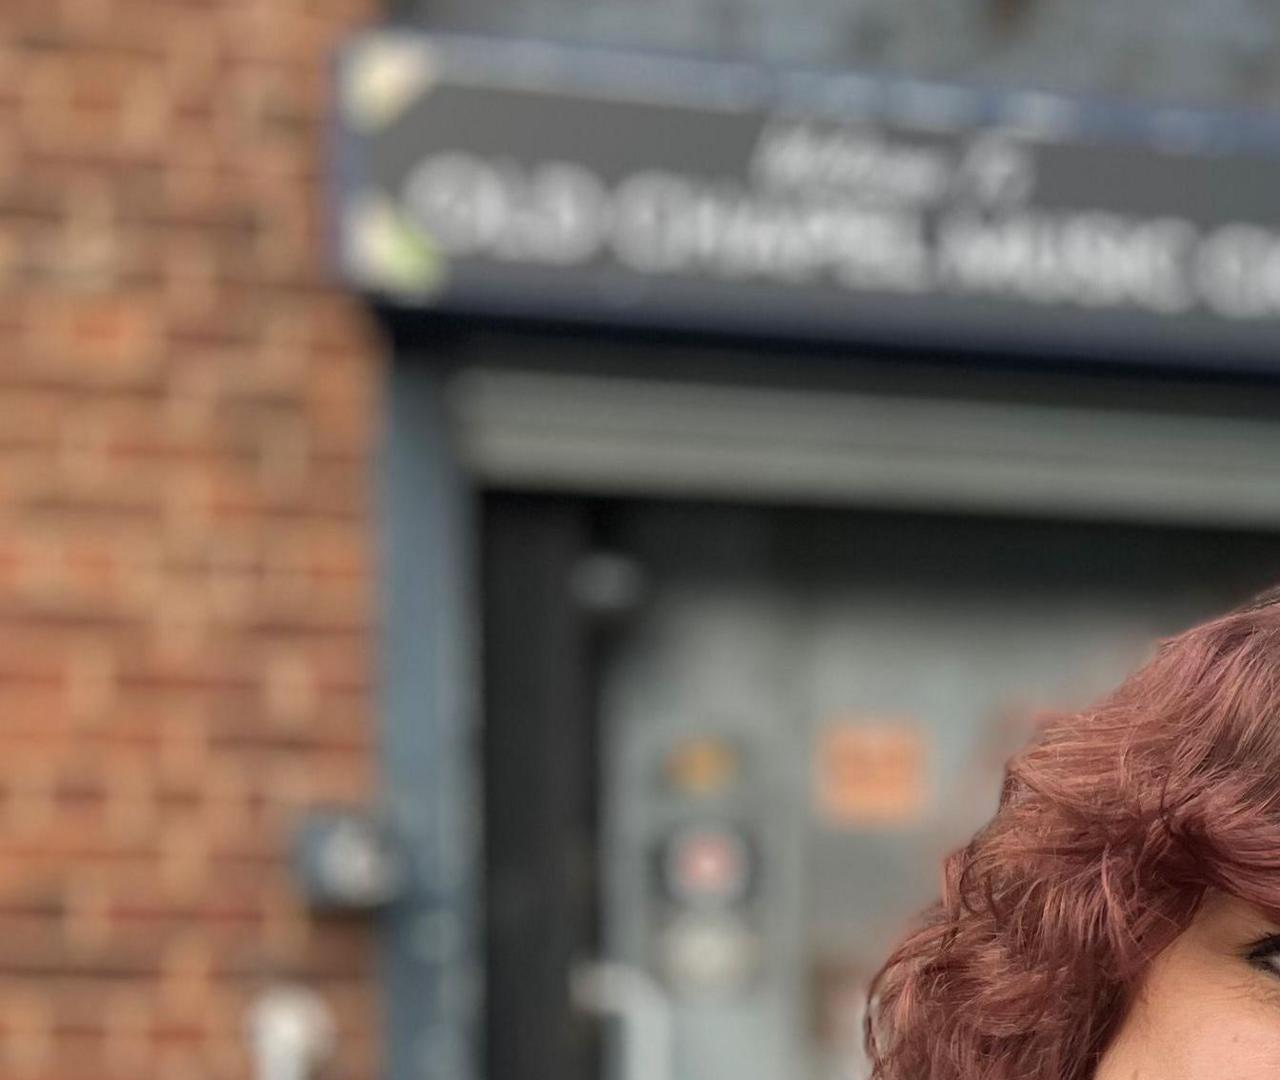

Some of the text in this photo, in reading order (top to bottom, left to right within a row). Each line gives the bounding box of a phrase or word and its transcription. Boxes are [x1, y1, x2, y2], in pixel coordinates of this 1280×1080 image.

[404, 156, 604, 258] OLD
[610, 174, 934, 290] CHAPEL
[944, 206, 1200, 310] MUSIC
